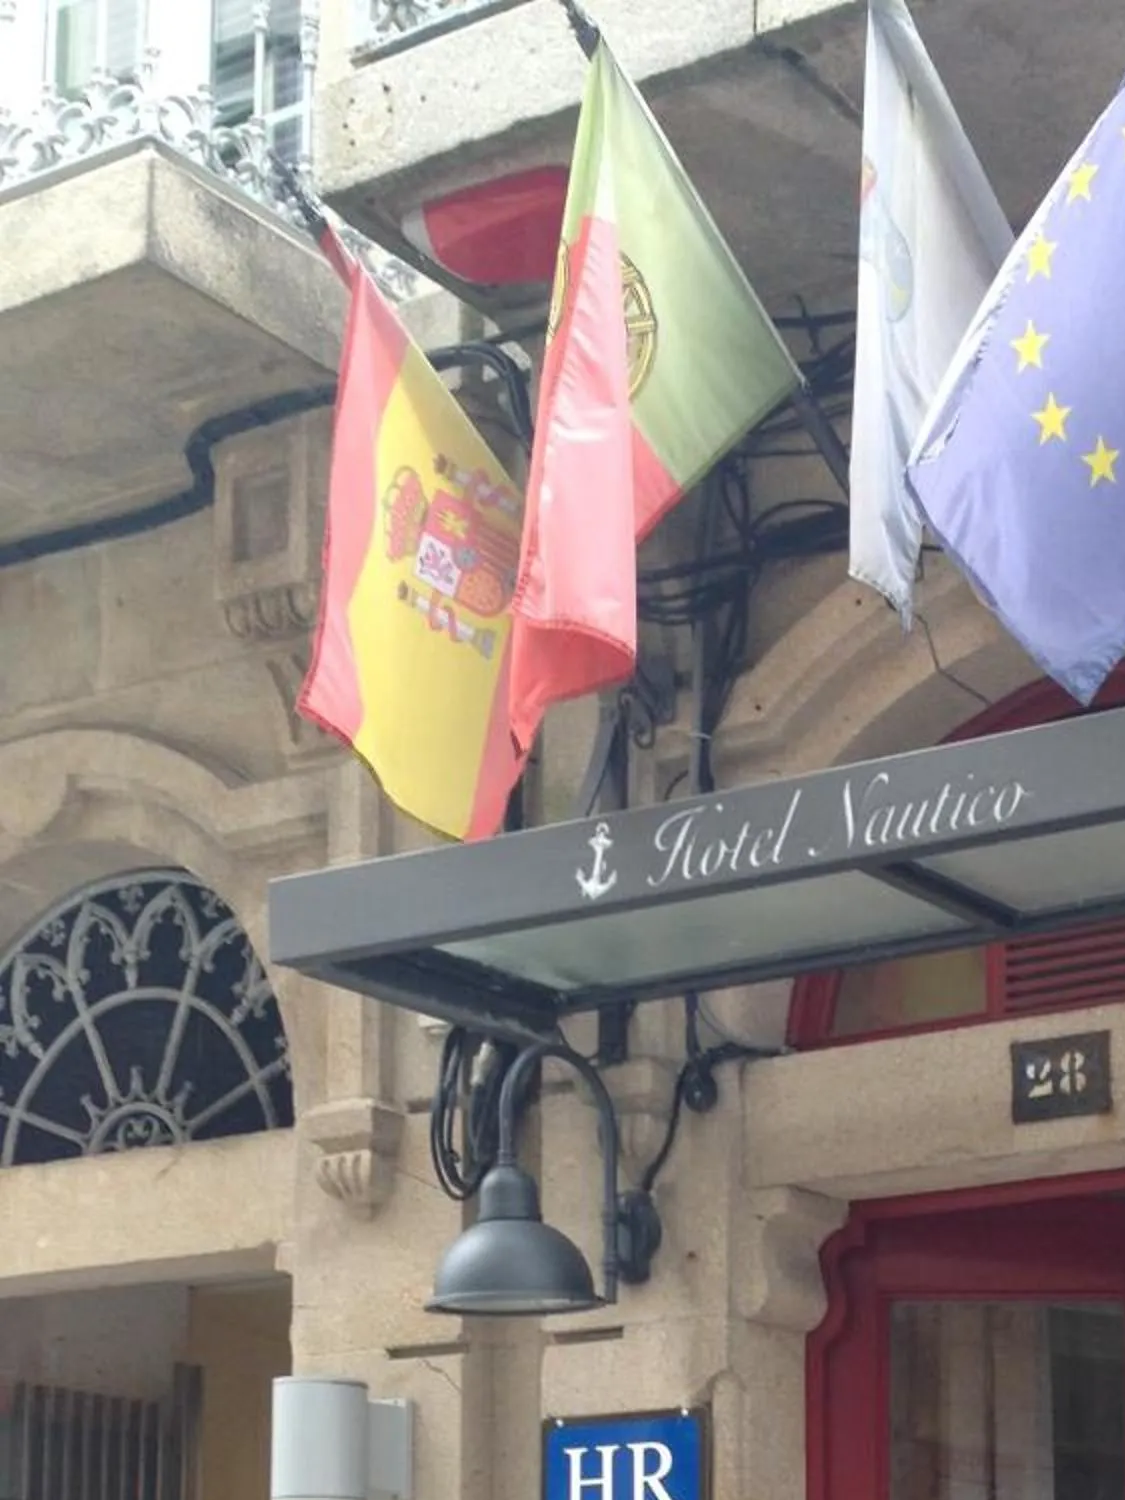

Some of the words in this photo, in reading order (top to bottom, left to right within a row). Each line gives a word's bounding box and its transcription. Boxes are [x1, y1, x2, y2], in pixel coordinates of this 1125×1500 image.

[647, 789, 802, 888] Hotel
[807, 773, 1031, 857] Nautico
[1026, 1051, 1087, 1098] 28
